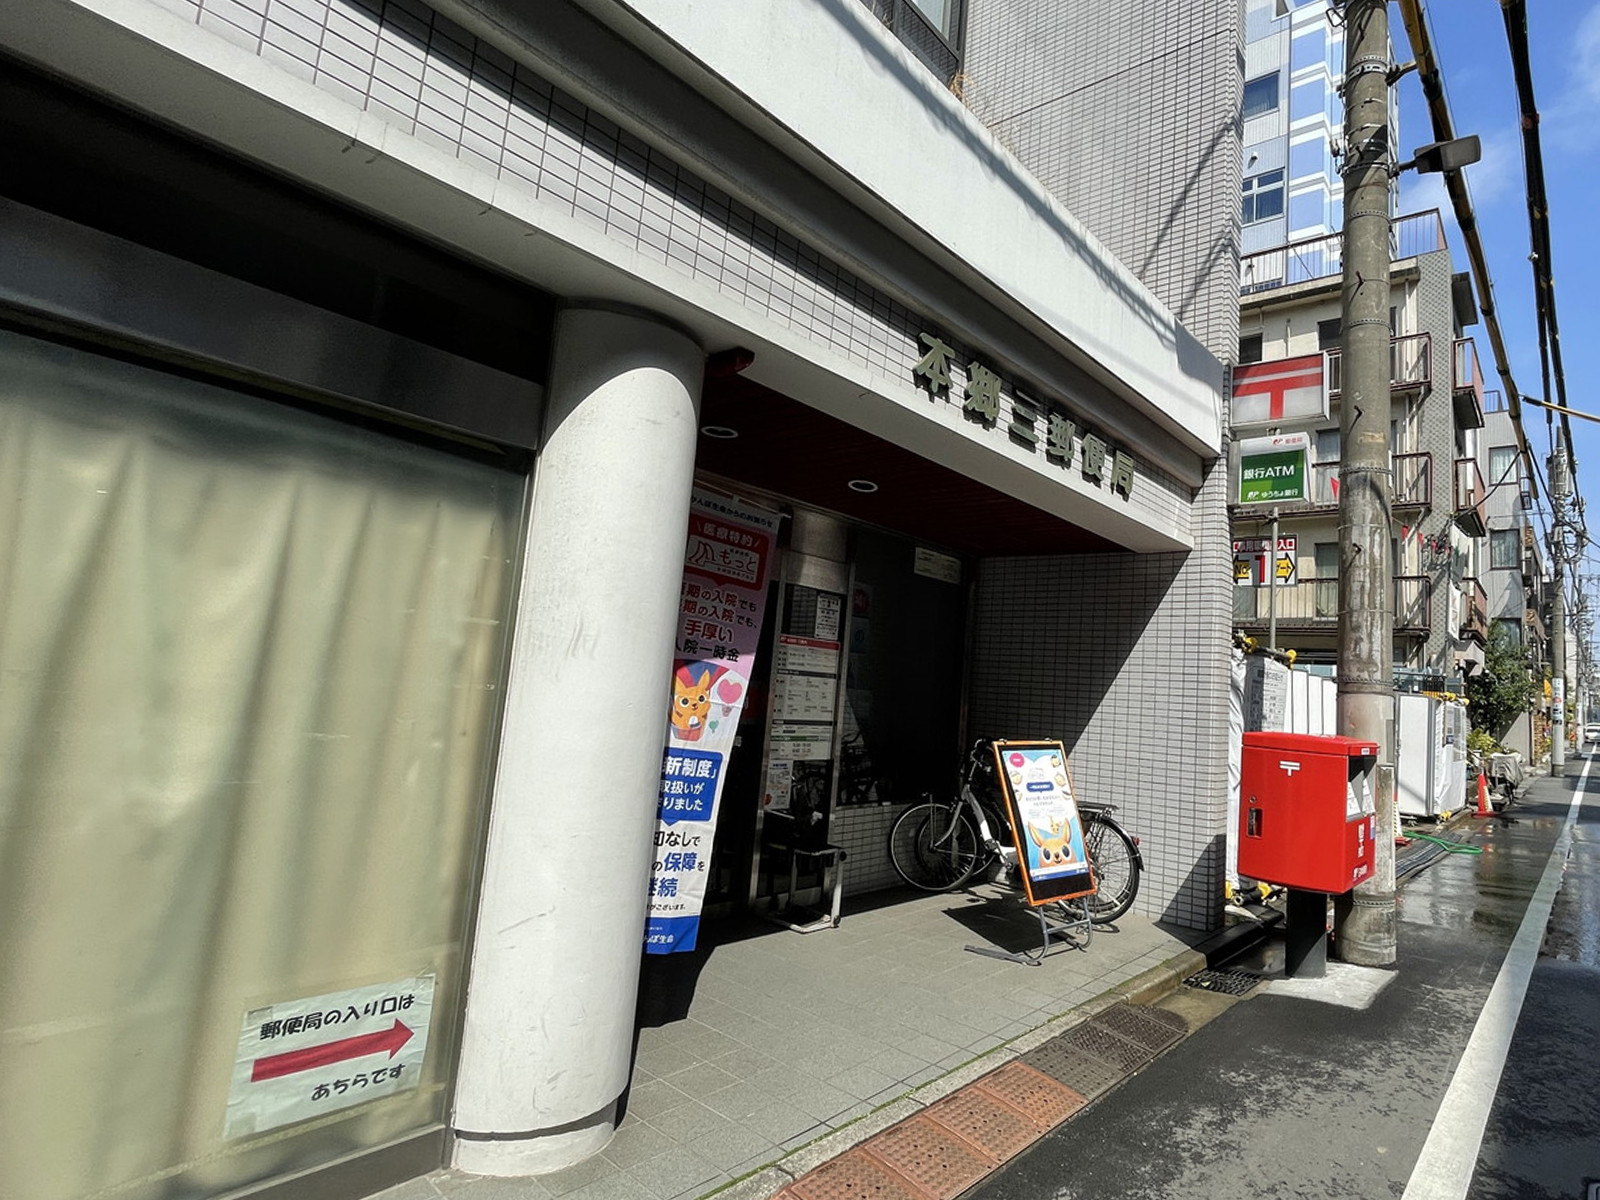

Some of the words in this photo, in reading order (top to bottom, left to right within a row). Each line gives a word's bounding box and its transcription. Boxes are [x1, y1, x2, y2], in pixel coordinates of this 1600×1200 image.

[912, 332, 1135, 499] 本郷三郵便局
[1243, 465, 1295, 480] 銀行ATM
[1261, 488, 1299, 499] ゆうちょ銀行
[703, 522, 753, 547] 医療特約
[719, 549, 757, 573] もっと
[1255, 555, 1265, 583] 1
[679, 598, 757, 629] 期の入院でも、
[685, 619, 733, 642] 手厚い
[652, 852, 705, 872] の保障を
[259, 993, 416, 1040] 郵便局の入り口は
[310, 1063, 406, 1102] あちらです
